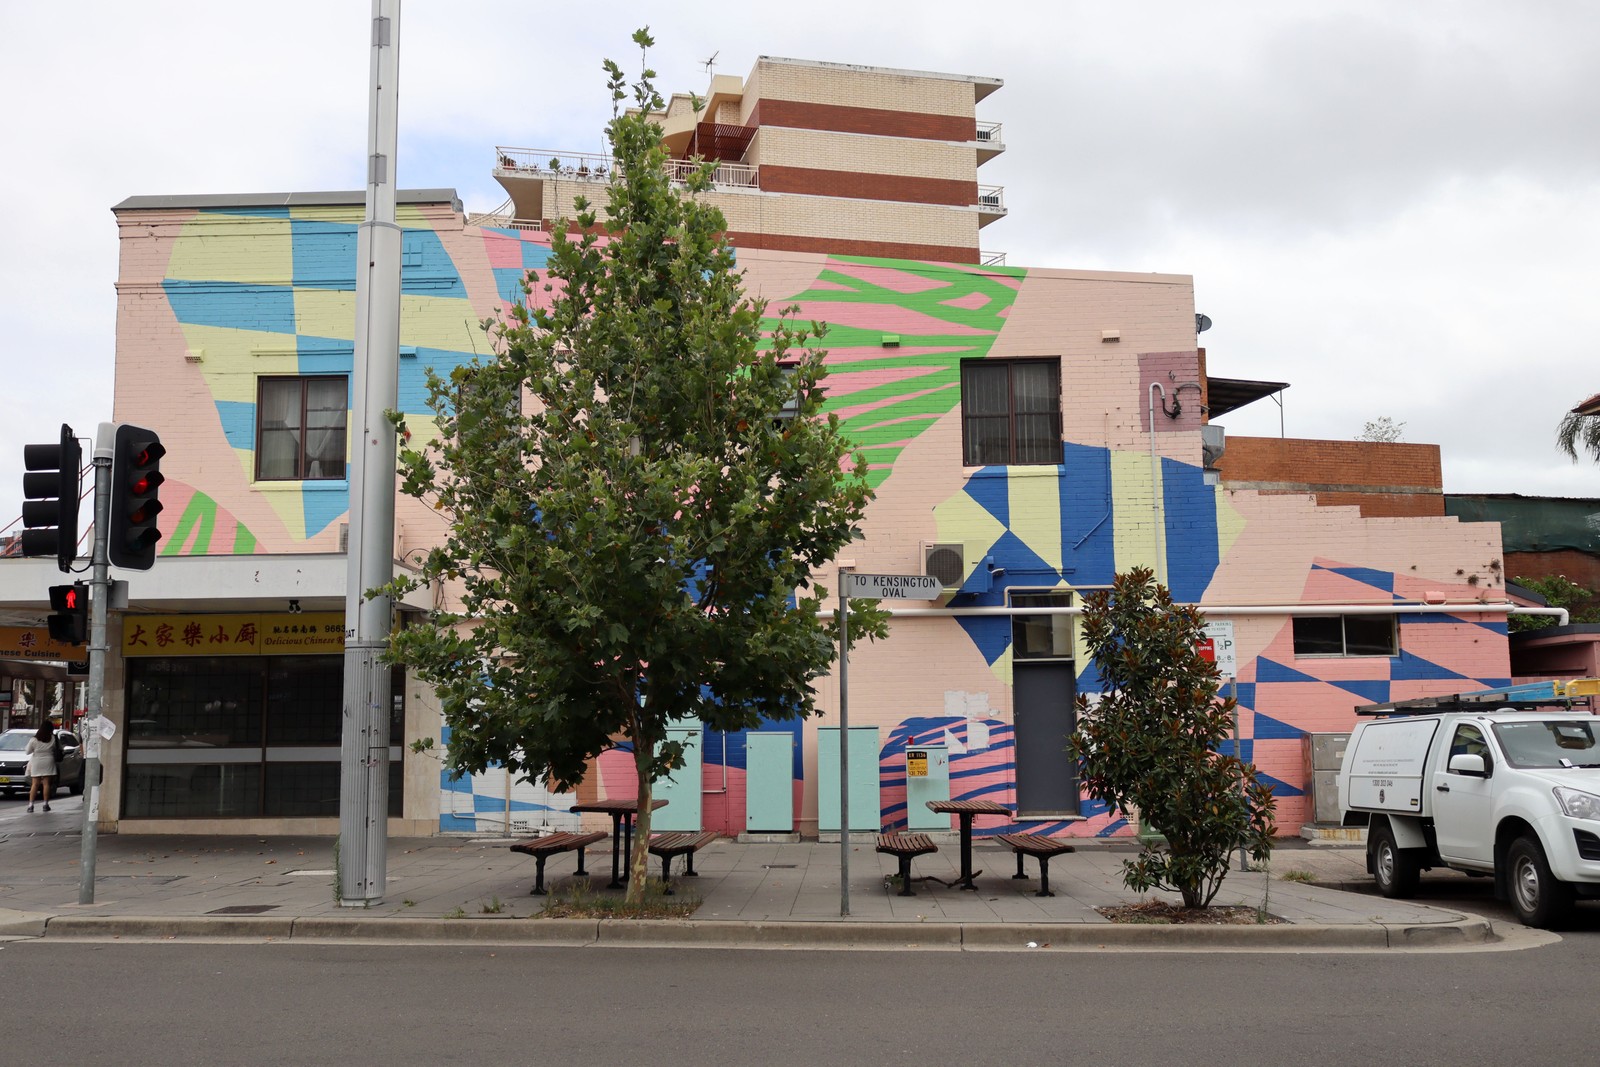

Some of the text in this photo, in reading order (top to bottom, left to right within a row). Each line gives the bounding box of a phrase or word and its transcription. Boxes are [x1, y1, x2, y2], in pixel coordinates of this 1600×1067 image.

[854, 576, 936, 588] TO KENSINGTON
[882, 587, 907, 598] OVAL
[264, 637, 303, 646] Delicious
[304, 635, 334, 646] Chinese
[24, 649, 61, 658] Cuisine
